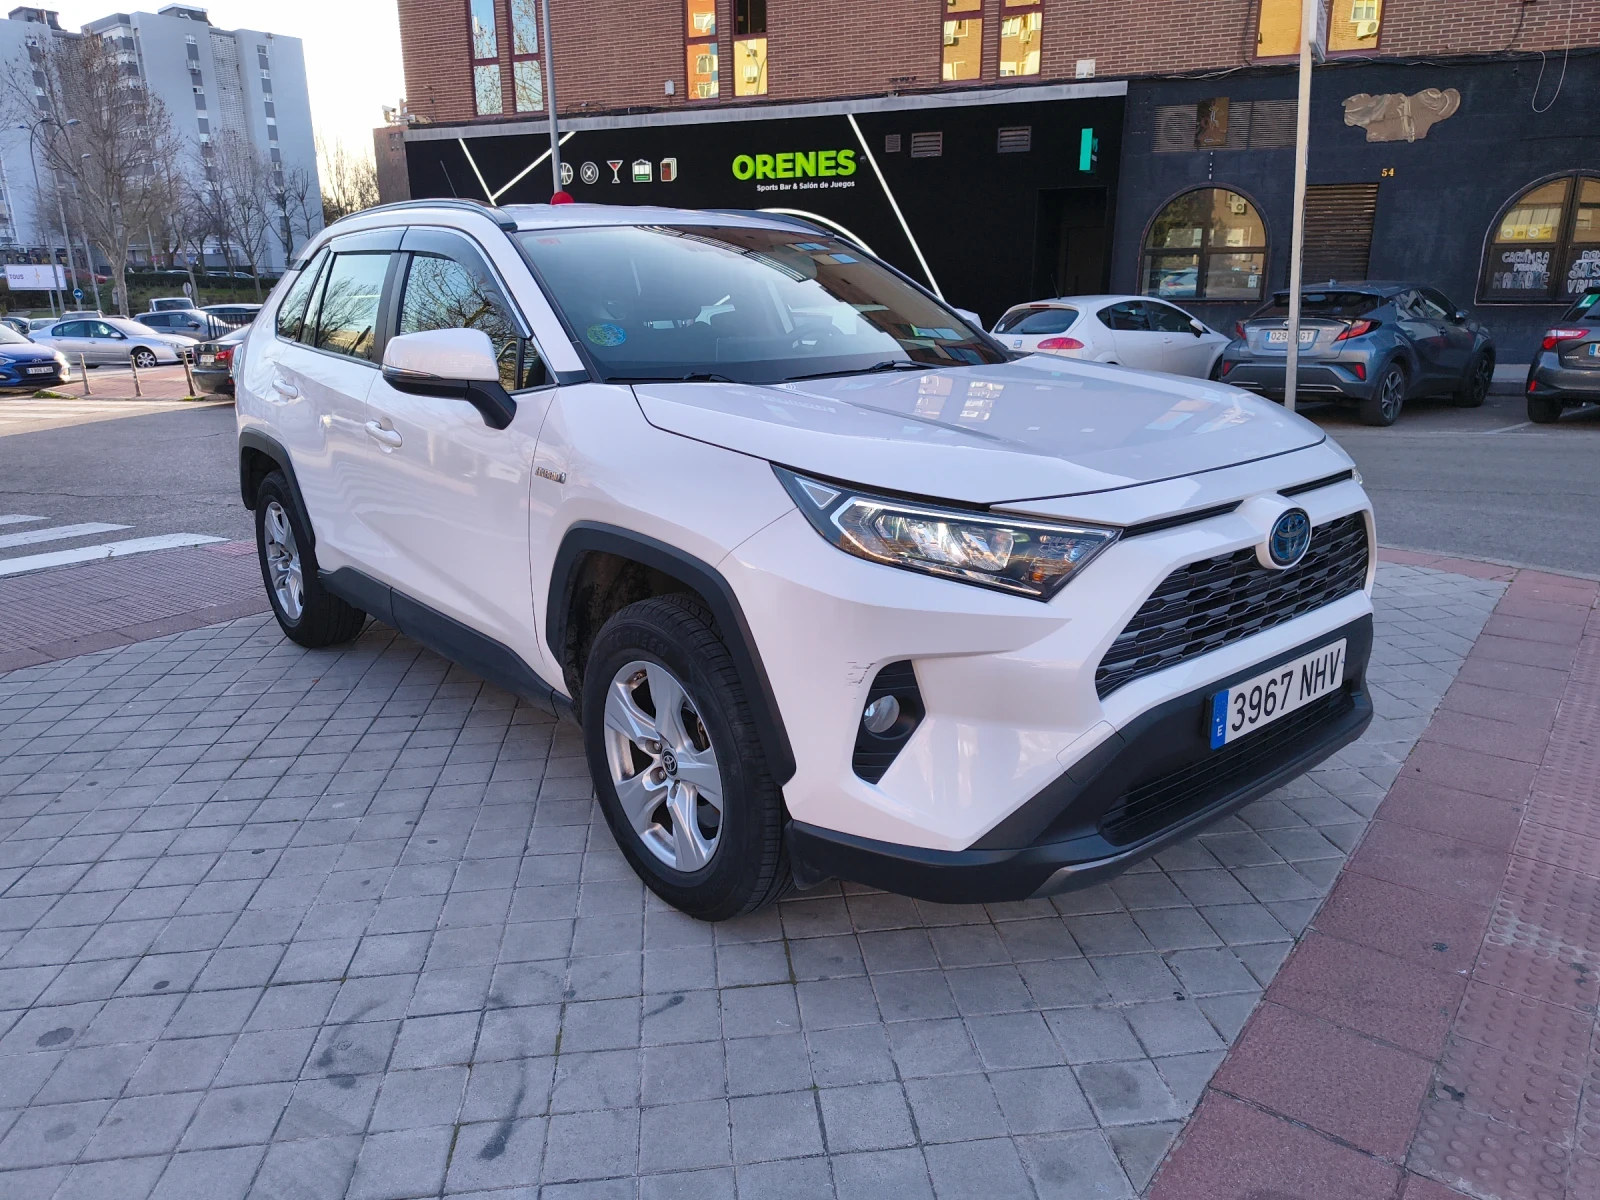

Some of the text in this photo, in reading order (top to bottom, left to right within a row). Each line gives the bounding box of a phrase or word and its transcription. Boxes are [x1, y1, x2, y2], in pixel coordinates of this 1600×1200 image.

[732, 149, 857, 180] ORENES
[1381, 167, 1395, 177] 54
[756, 184, 779, 192] Sports
[779, 183, 791, 191] Bar
[799, 181, 818, 190] Salón
[819, 181, 829, 189] de
[830, 180, 855, 189] Juegos
[1271, 331, 1289, 341] 029
[1231, 647, 1341, 732] 3967 NHV
